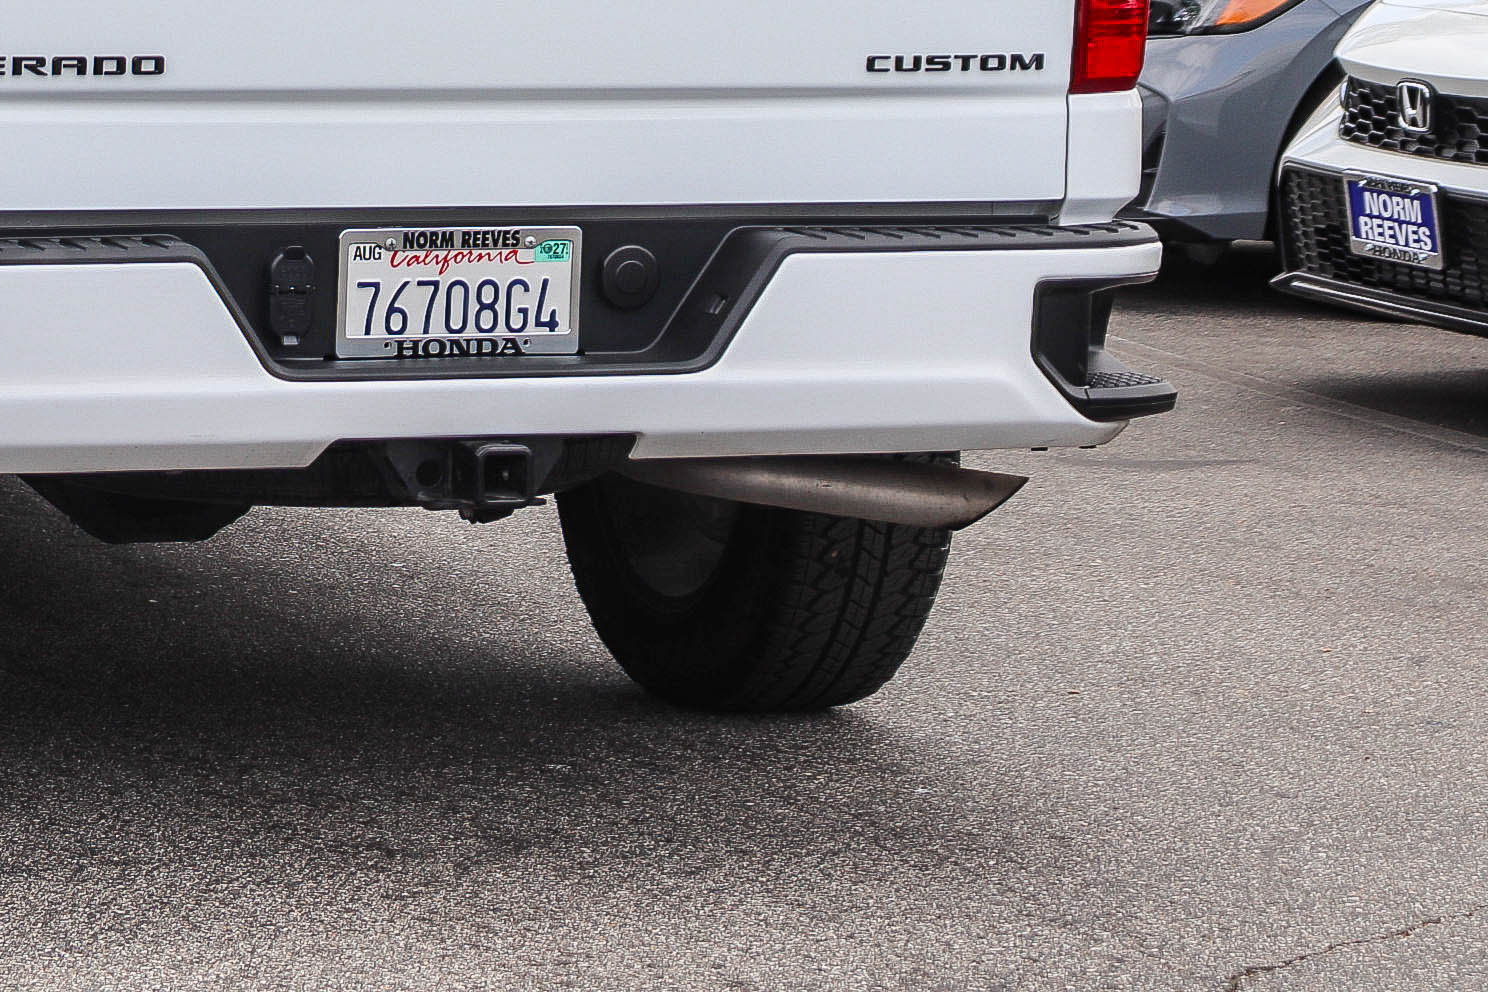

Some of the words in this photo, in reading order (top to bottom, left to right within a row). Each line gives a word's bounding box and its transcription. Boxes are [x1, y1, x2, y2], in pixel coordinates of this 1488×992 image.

[866, 53, 1045, 73] CUSTOM
[1364, 192, 1422, 224] NORM
[403, 231, 454, 249] NORM
[461, 229, 521, 248] REEVES
[1358, 216, 1432, 251] REEVES
[353, 245, 382, 261] AUG
[390, 249, 534, 275] California
[356, 277, 559, 336] 76708G4
[394, 338, 525, 358] HONDA
